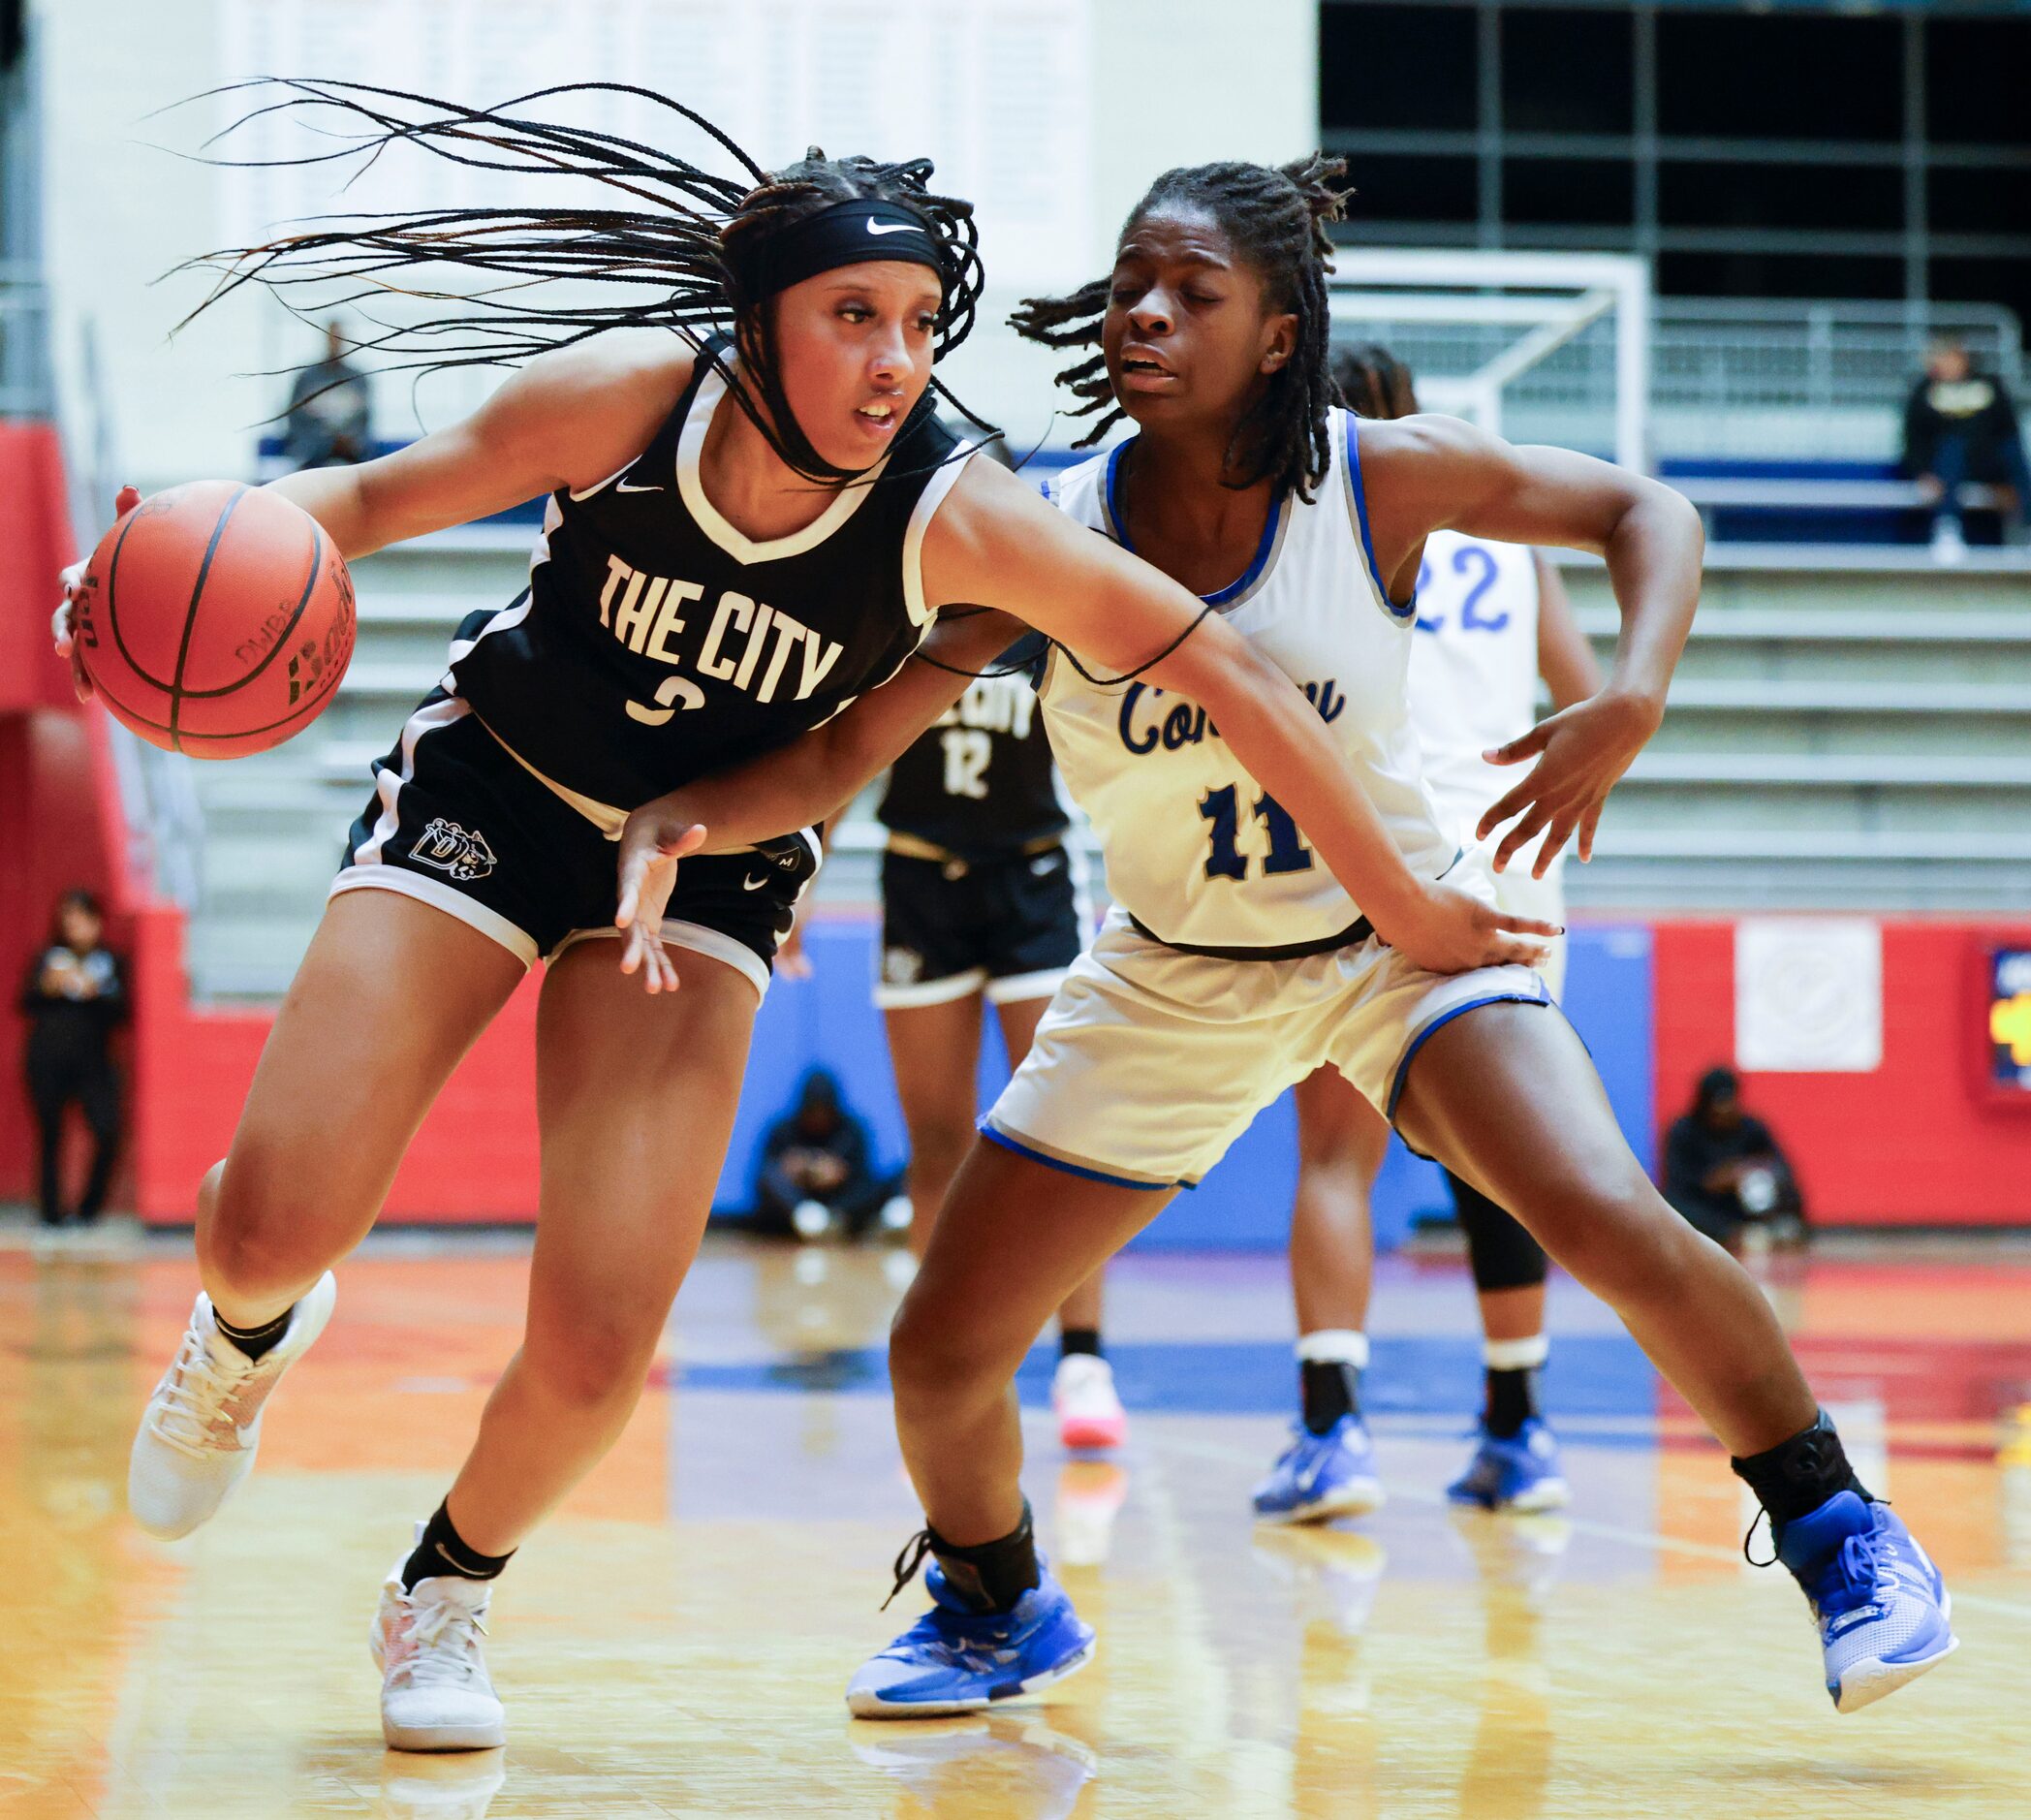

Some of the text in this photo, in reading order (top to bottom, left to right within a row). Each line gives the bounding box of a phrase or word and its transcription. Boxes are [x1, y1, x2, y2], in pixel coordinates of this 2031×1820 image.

[599, 552, 844, 705] THE CITY
[941, 729, 992, 800] 12
[1196, 781, 1315, 883] 11
